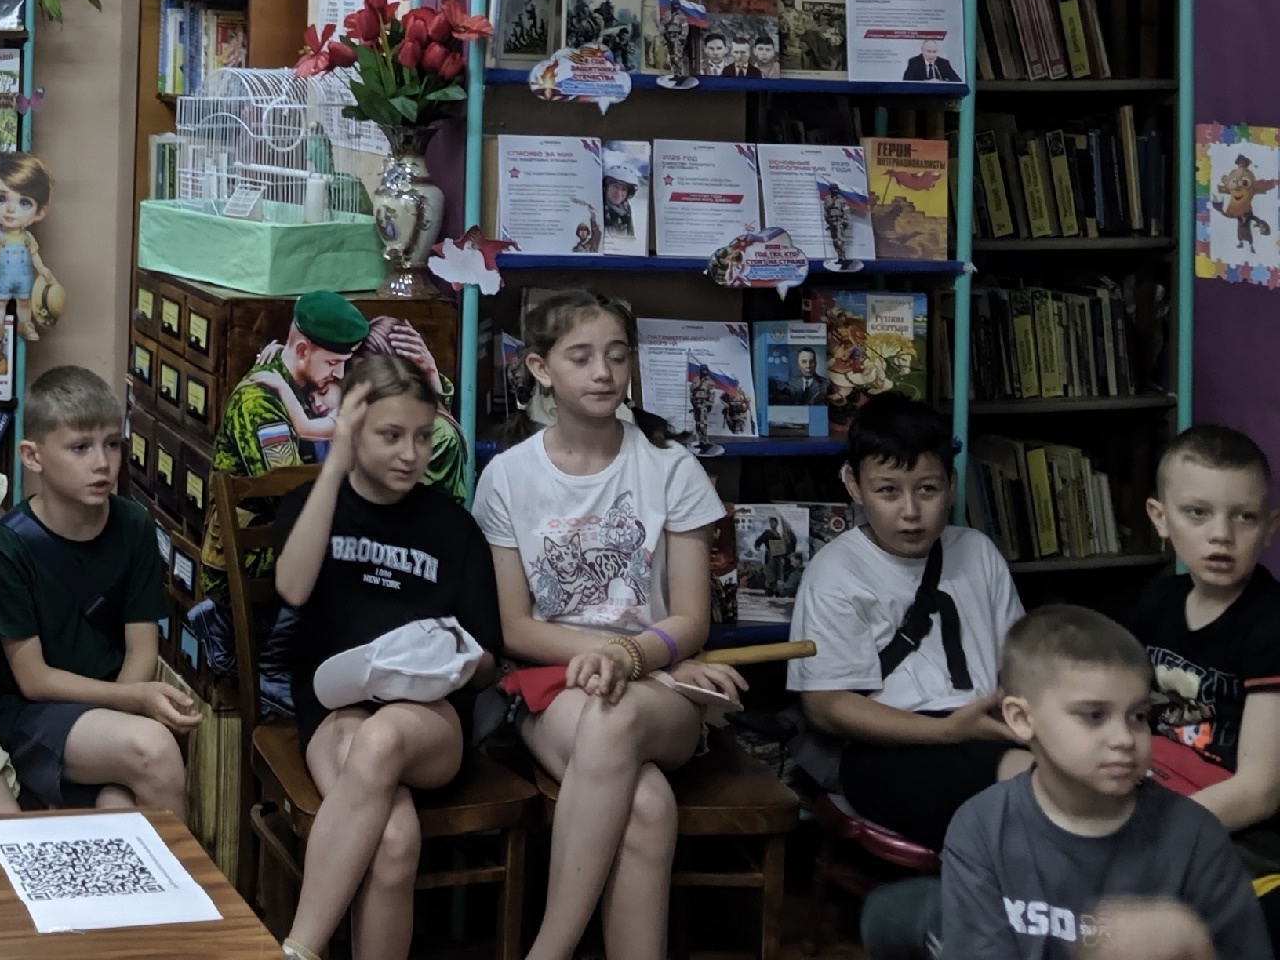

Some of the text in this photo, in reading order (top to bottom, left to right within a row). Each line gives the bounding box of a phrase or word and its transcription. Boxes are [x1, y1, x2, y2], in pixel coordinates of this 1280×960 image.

[331, 535, 439, 584] BROOKLYN
[362, 574, 402, 590] NEW YORK
